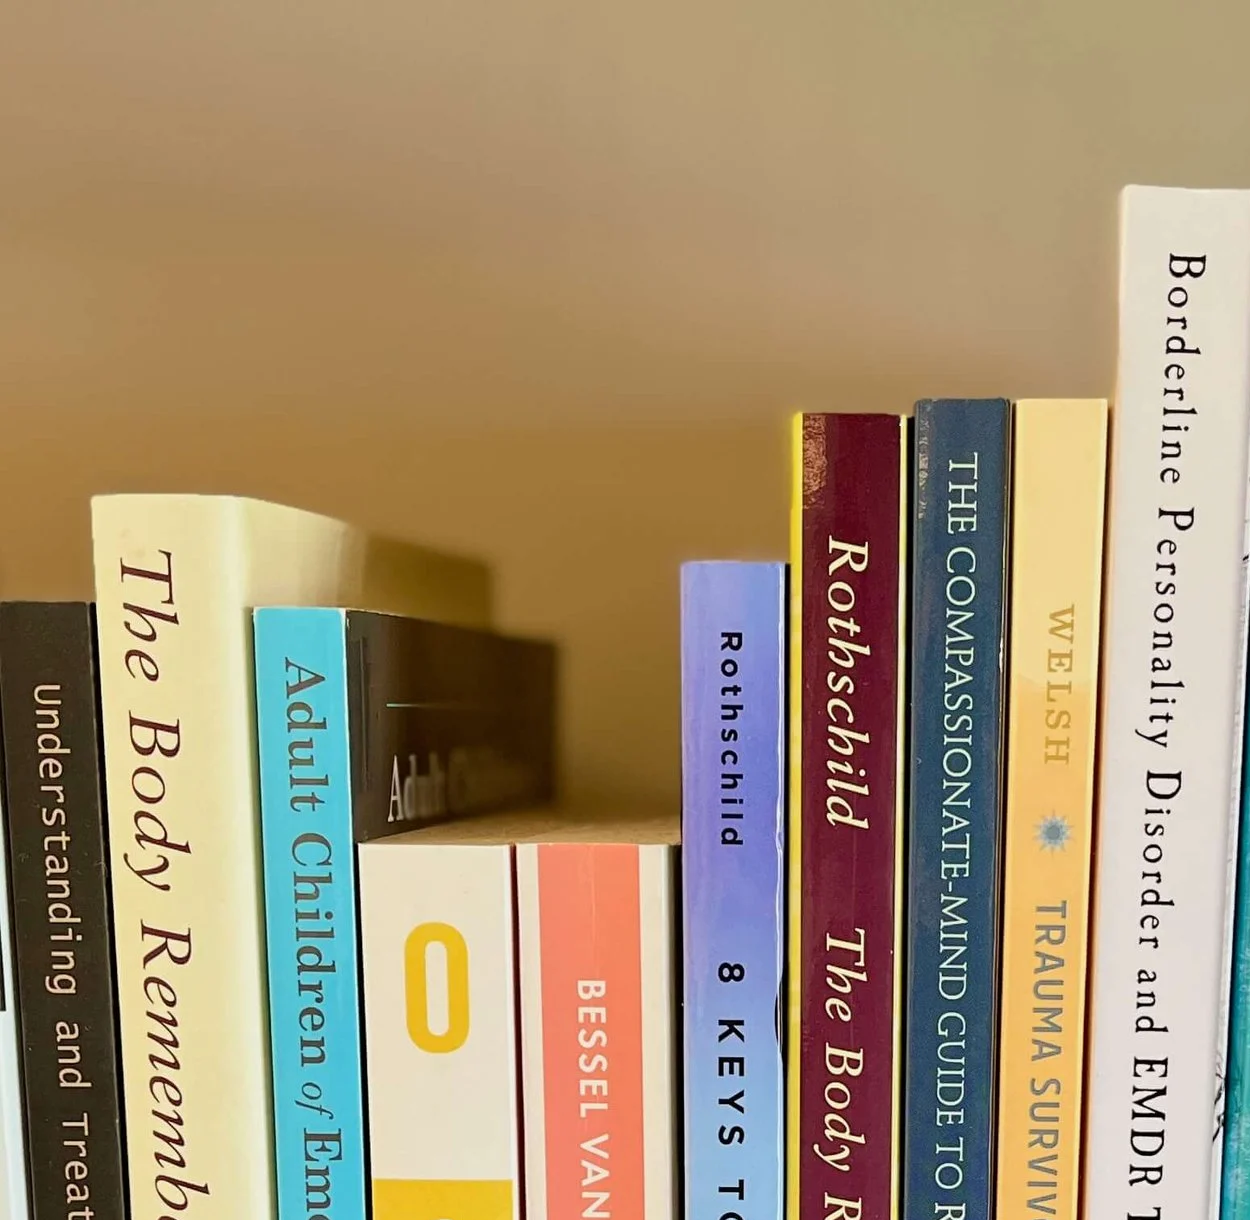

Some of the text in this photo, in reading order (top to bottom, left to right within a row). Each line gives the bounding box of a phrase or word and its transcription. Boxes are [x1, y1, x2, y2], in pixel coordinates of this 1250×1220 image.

[1160, 253, 1206, 483] Borderline
[948, 452, 978, 534] THE
[120, 550, 179, 681] The
[827, 535, 870, 828] Rothschild
[1135, 508, 1194, 747] Personality
[285, 657, 329, 812] Adult
[721, 632, 743, 845] Rothschild
[1044, 604, 1074, 765] WELSH
[34, 685, 81, 993] Understanding
[124, 710, 191, 891] Body
[939, 547, 976, 999] COMPASSIONATE-MIND
[1139, 771, 1182, 949] Disorder
[292, 833, 336, 1067] Children
[718, 963, 744, 982] 8
[826, 928, 867, 1021] The
[1032, 900, 1067, 1061] TRAUMA
[1136, 970, 1168, 1032] and
[56, 1022, 91, 1087] and
[295, 1082, 333, 1119] of
[578, 981, 608, 1117] BESSEL
[718, 1020, 744, 1144] KEYS
[814, 1042, 865, 1171] Body
[937, 1012, 965, 1126] GUIDE
[581, 1134, 610, 1218] VAN
[935, 1137, 963, 1189] TO
[1129, 1057, 1168, 1186] EMDR
